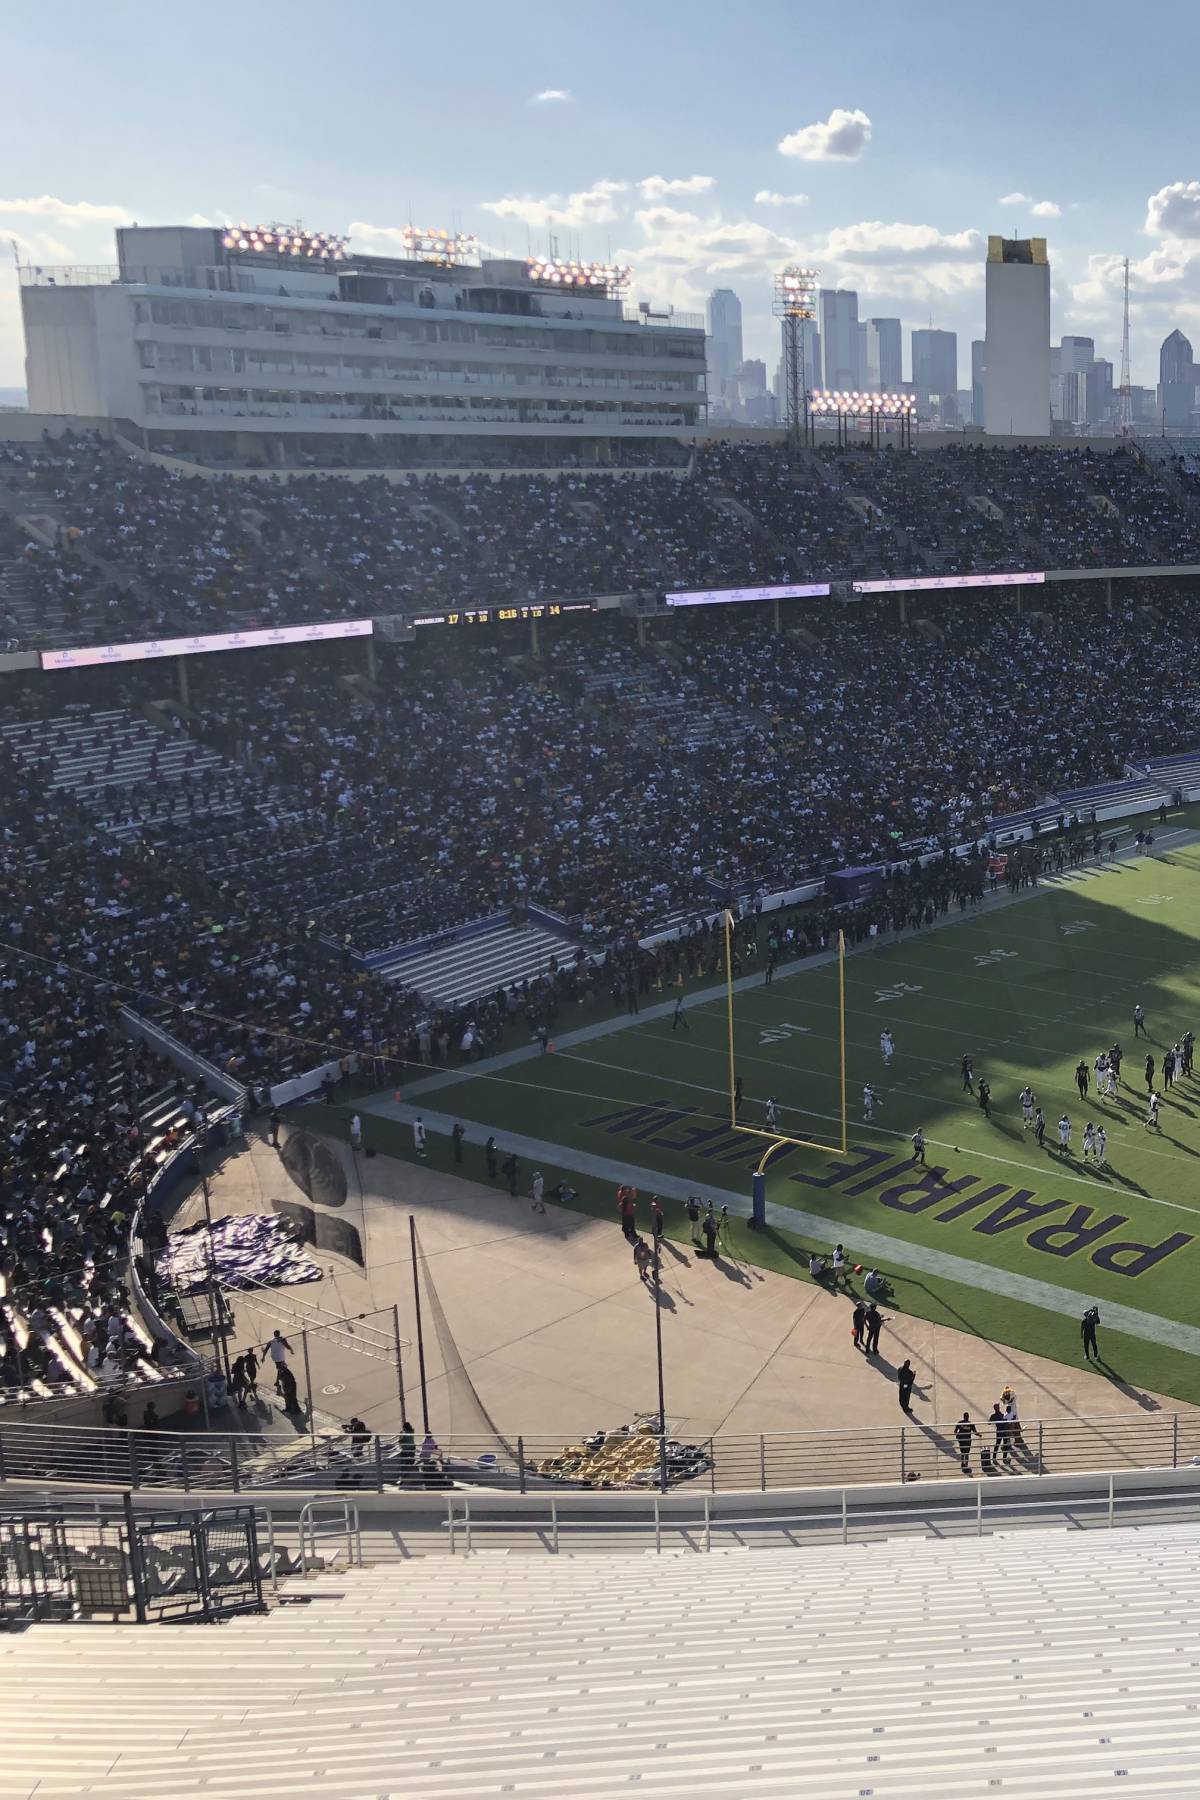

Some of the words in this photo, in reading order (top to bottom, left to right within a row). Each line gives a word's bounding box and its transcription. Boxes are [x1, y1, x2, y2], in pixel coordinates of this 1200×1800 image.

[448, 614, 459, 625] 17
[498, 609, 517, 620] 8:16
[549, 605, 560, 615] 14
[874, 982, 924, 1000] 20
[760, 1023, 812, 1041] 10
[578, 1099, 815, 1170] VIEW
[788, 1145, 1196, 1278] PRAIRIE
